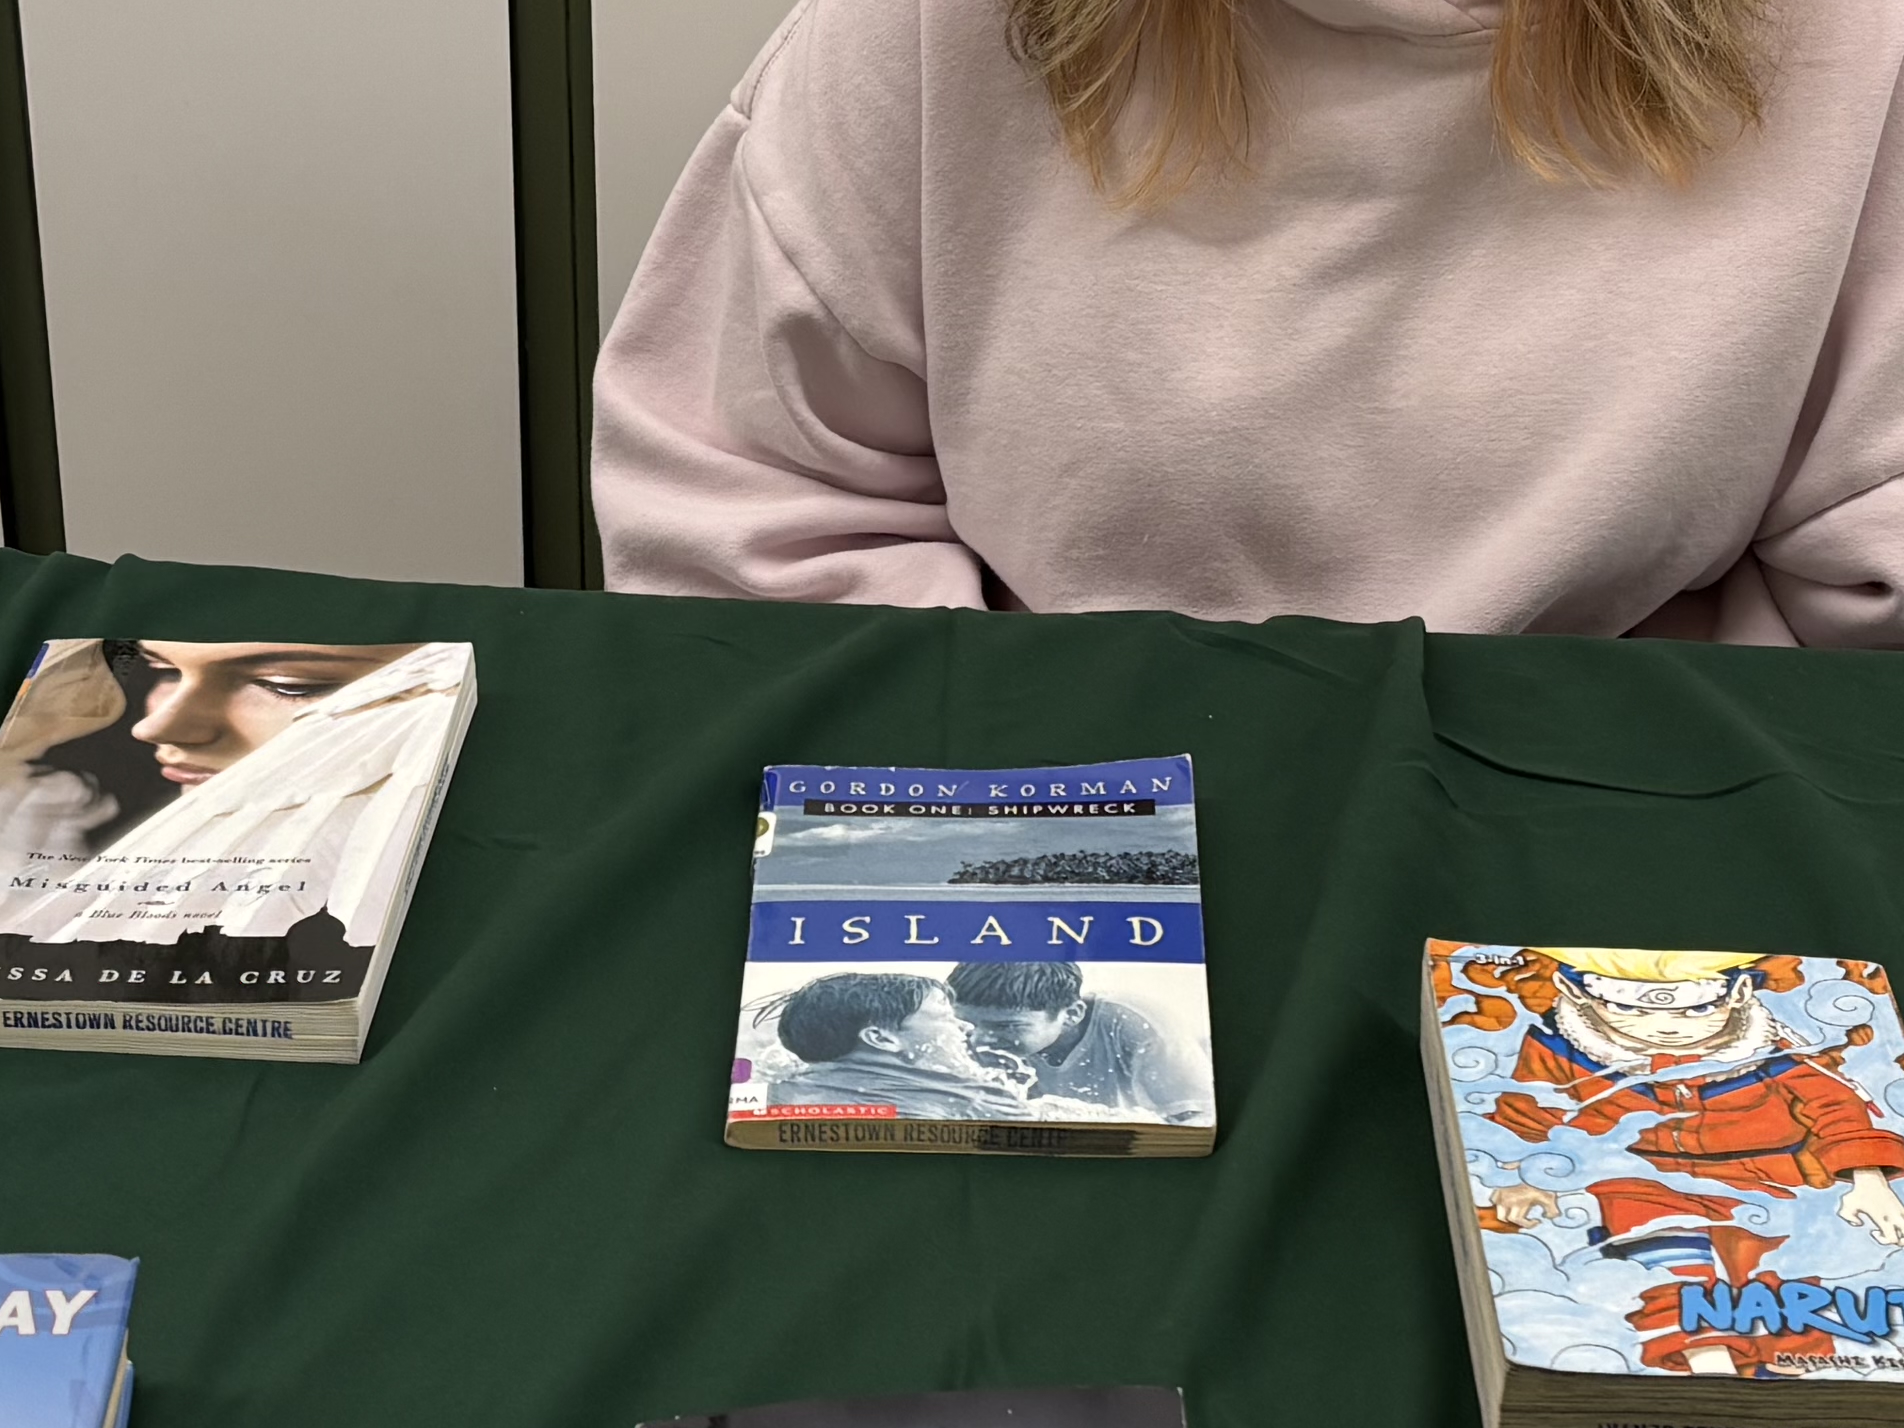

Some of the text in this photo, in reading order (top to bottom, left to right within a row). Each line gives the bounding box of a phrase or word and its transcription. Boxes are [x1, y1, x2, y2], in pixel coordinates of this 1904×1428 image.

[788, 776, 1173, 798] GORDON KORMAN
[823, 802, 1137, 815] BOOK SHIPWRECK
[8, 876, 307, 894] Misguided Angel
[787, 914, 1165, 945] ISLAND
[1475, 953, 1525, 966] 3-in-1
[98, 969, 147, 984] DE
[169, 969, 214, 985] LA
[239, 969, 343, 985] CRUZ
[2, 1010, 293, 1039] ERNESTOWN RESOURCE CENTRE
[778, 1122, 997, 1146] ERNESTOWN RESOURCE
[1774, 1352, 1867, 1368] MASASHI
